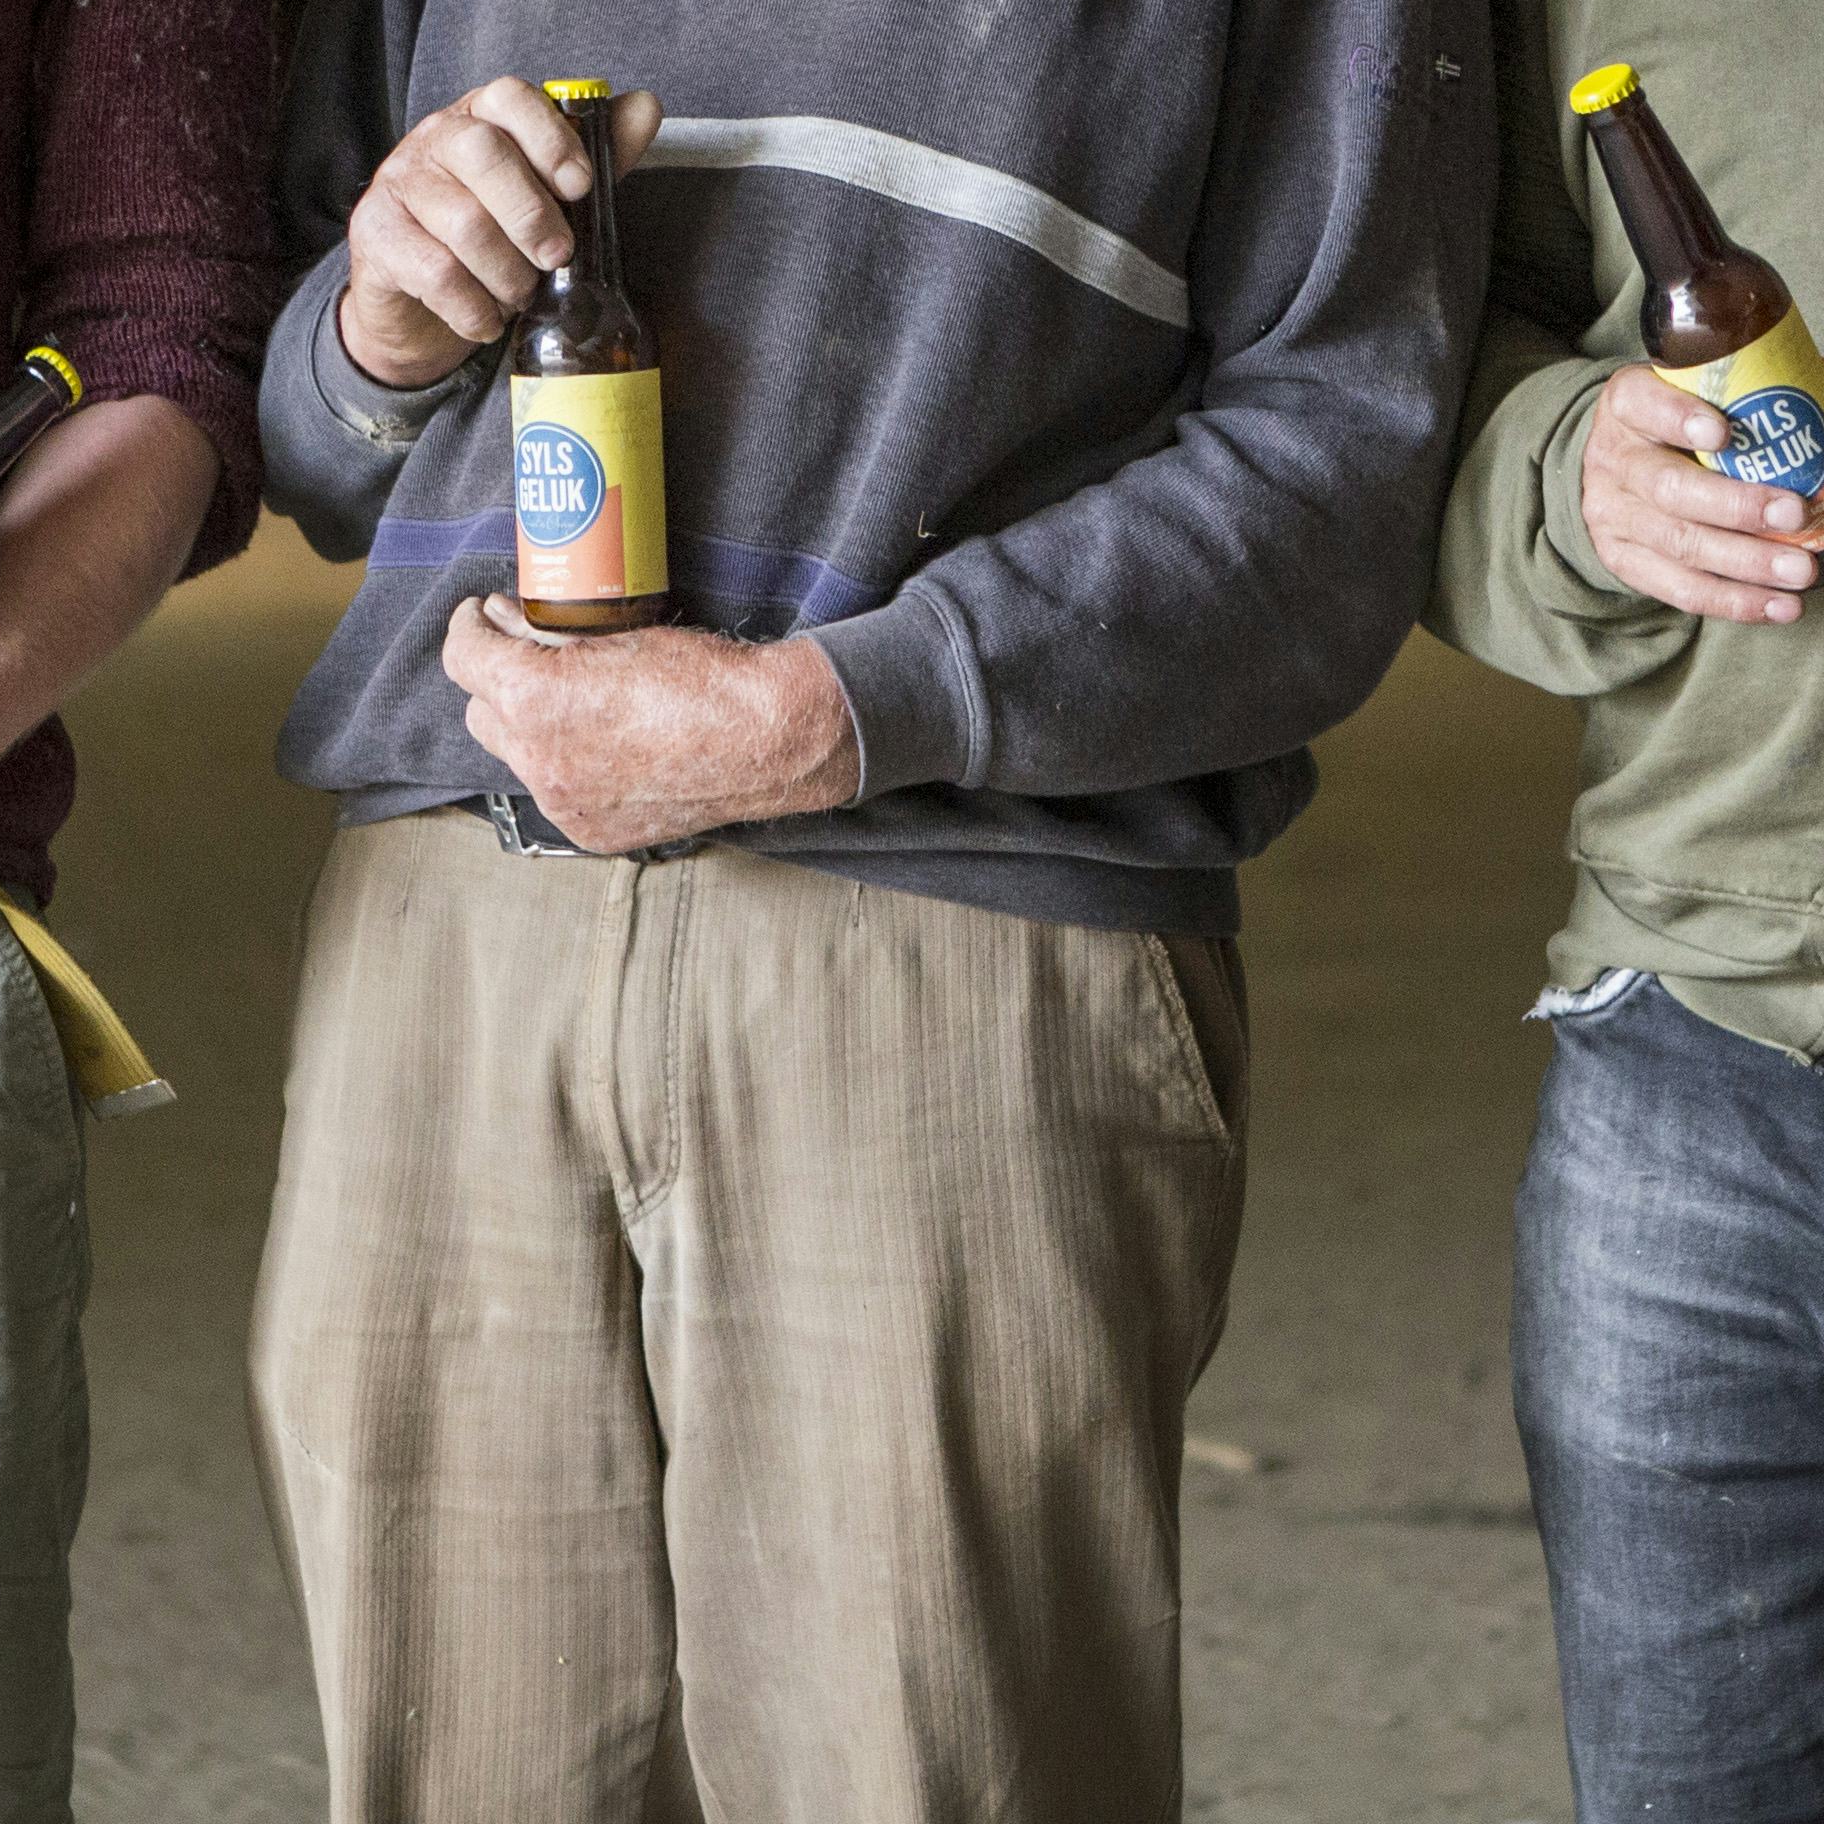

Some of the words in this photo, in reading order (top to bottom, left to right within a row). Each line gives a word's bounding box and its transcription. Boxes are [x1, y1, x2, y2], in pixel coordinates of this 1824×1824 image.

[1730, 399, 1797, 451] SYLS
[520, 441, 574, 476] SYLS
[1734, 424, 1823, 484] GELUK
[518, 477, 587, 513] GELUK
